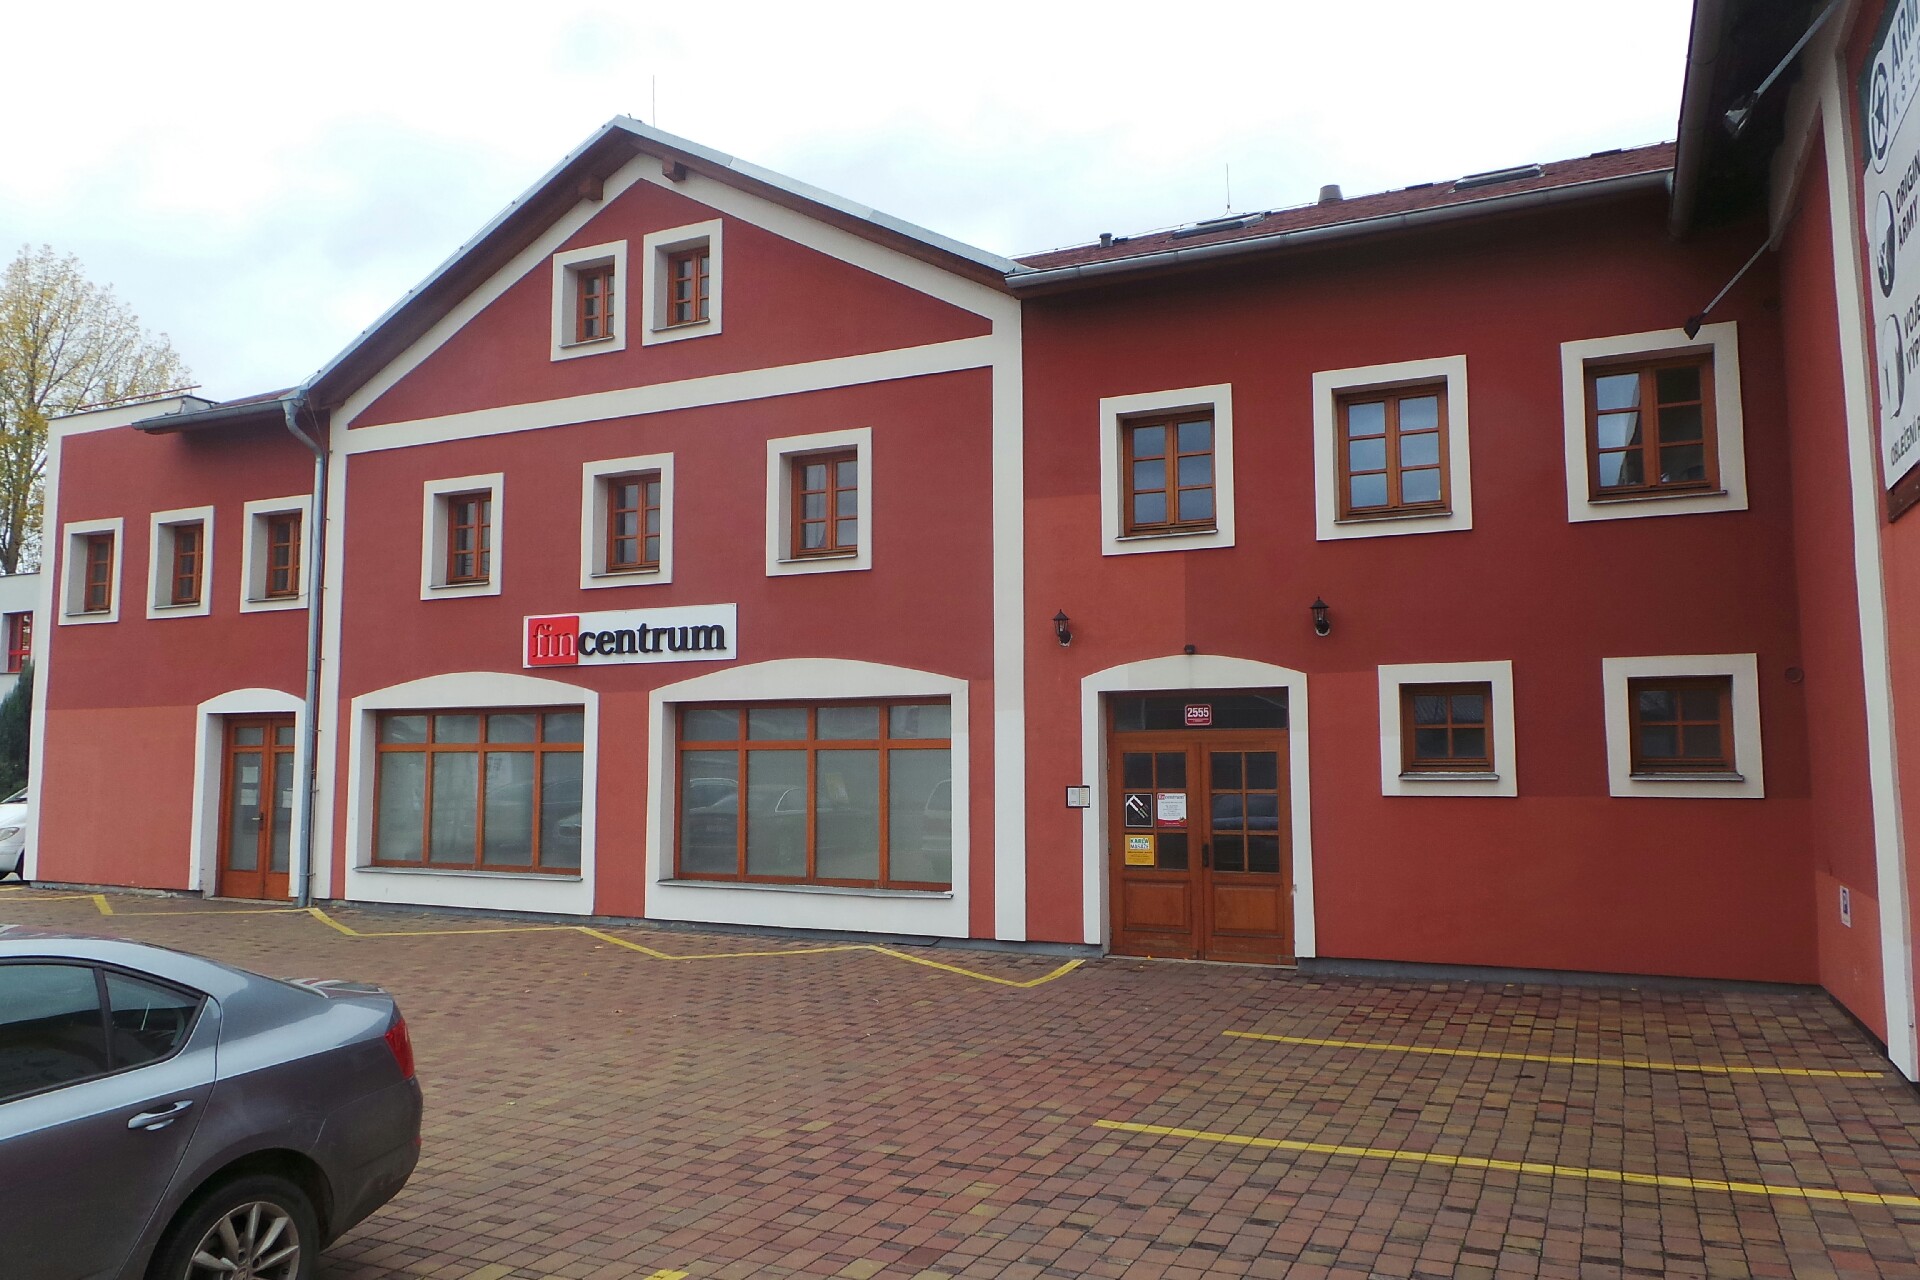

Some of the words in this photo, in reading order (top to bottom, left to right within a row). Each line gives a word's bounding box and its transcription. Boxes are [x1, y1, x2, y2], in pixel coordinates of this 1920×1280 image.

[1899, 194, 1917, 252] ARMY
[532, 622, 728, 658] fincentrum
[1187, 707, 1209, 718] 2555
